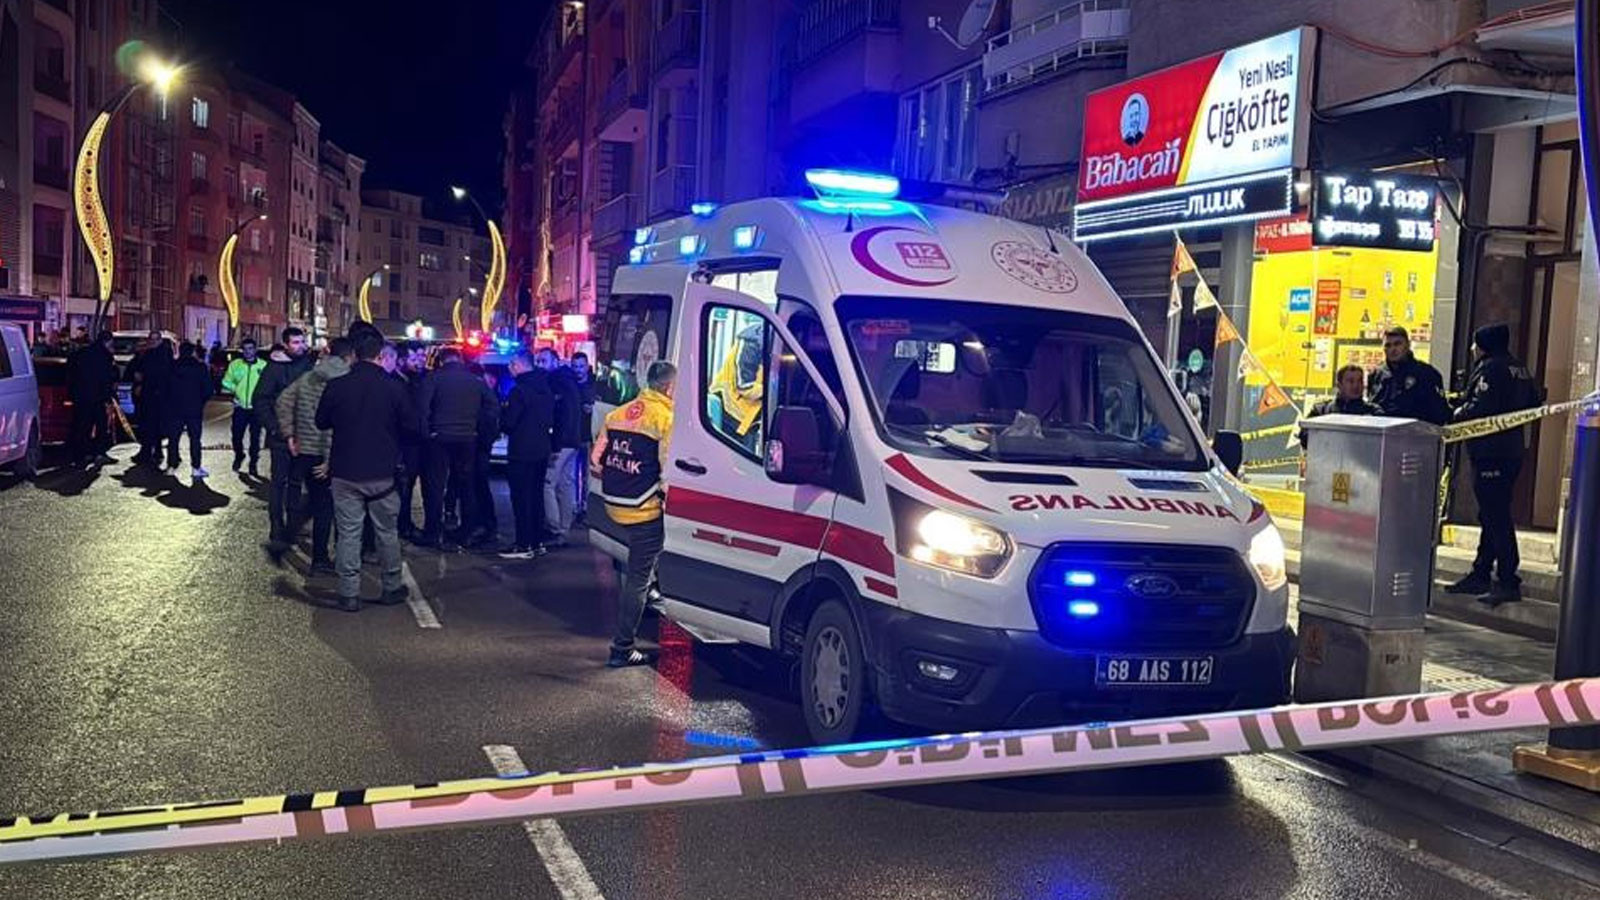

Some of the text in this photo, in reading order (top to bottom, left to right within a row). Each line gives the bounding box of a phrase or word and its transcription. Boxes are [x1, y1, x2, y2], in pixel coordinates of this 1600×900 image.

[1239, 55, 1293, 89] Yeni Nesil
[1206, 89, 1290, 148] Çiğköfte
[1325, 176, 1372, 212] Tap
[903, 245, 938, 258] 112
[1108, 660, 1210, 682] 68 AAS 112
